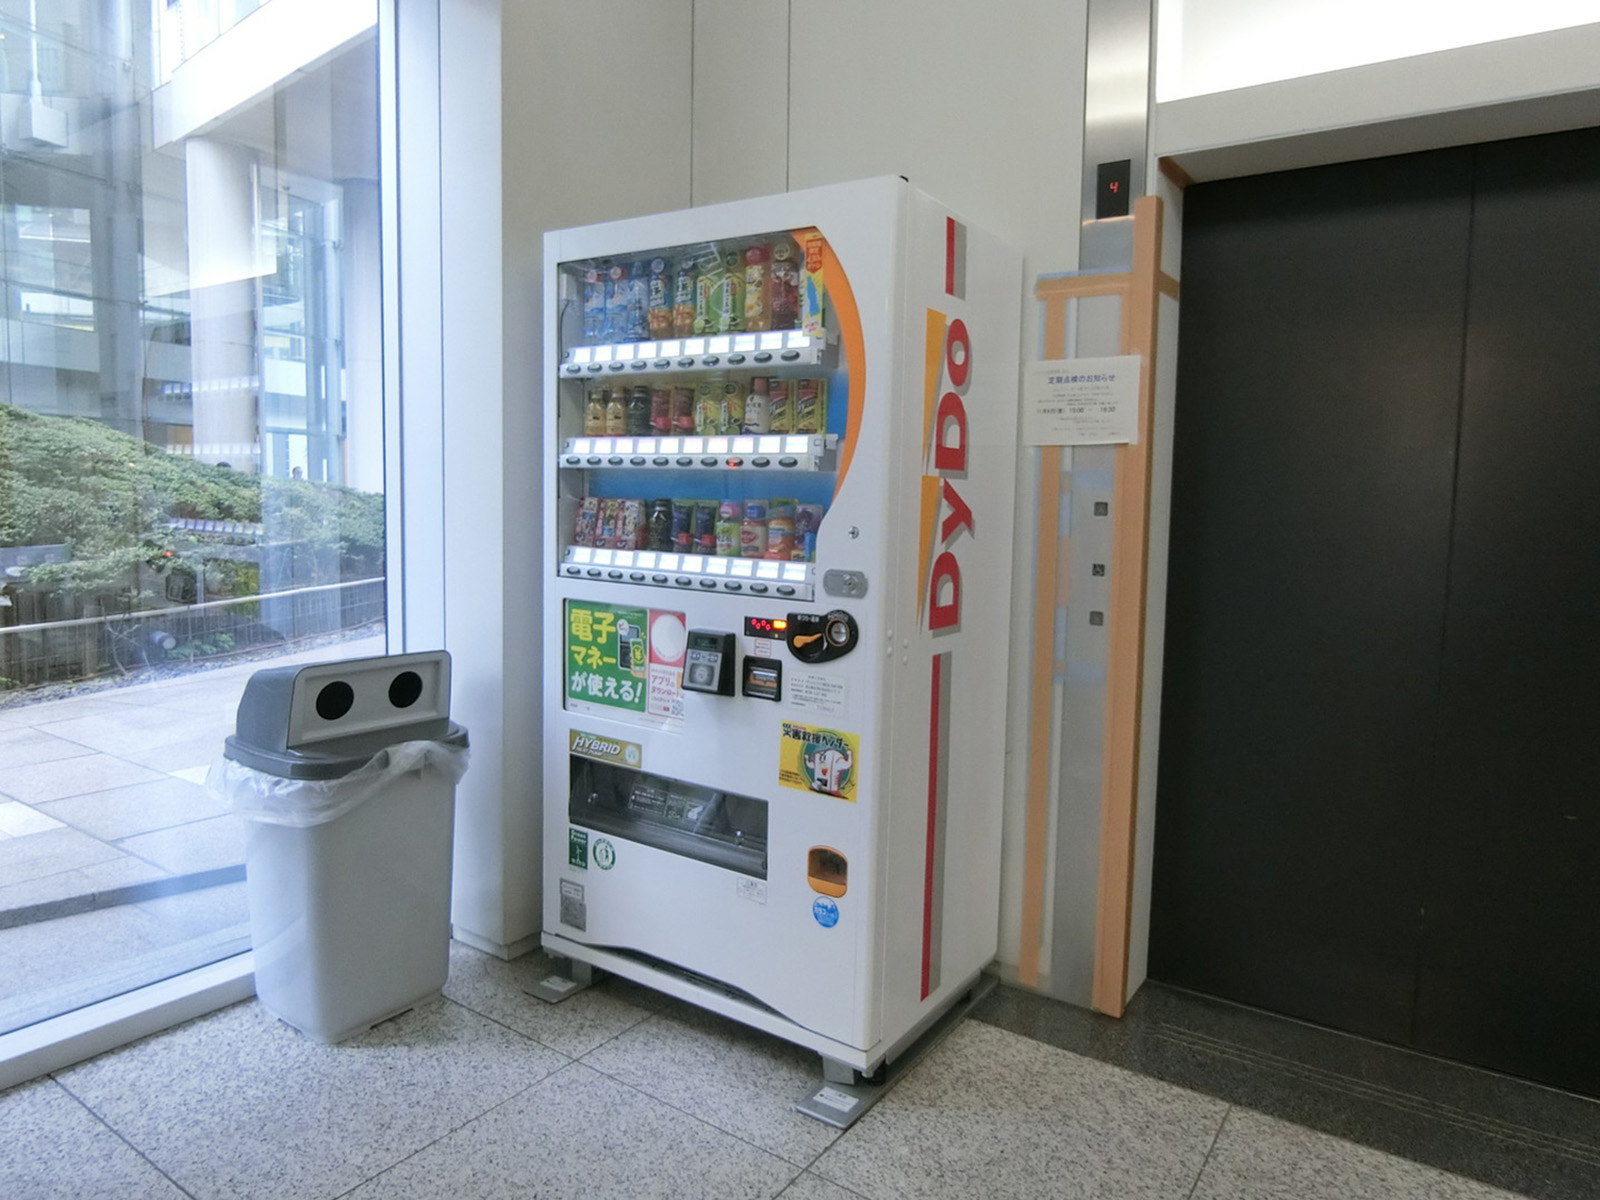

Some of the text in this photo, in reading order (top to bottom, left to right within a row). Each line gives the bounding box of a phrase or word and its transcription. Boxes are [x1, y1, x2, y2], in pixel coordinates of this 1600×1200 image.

[1109, 181, 1119, 193] 4
[570, 608, 617, 644] 電子
[570, 645, 617, 669] マネー
[571, 736, 621, 755] HYBRID
